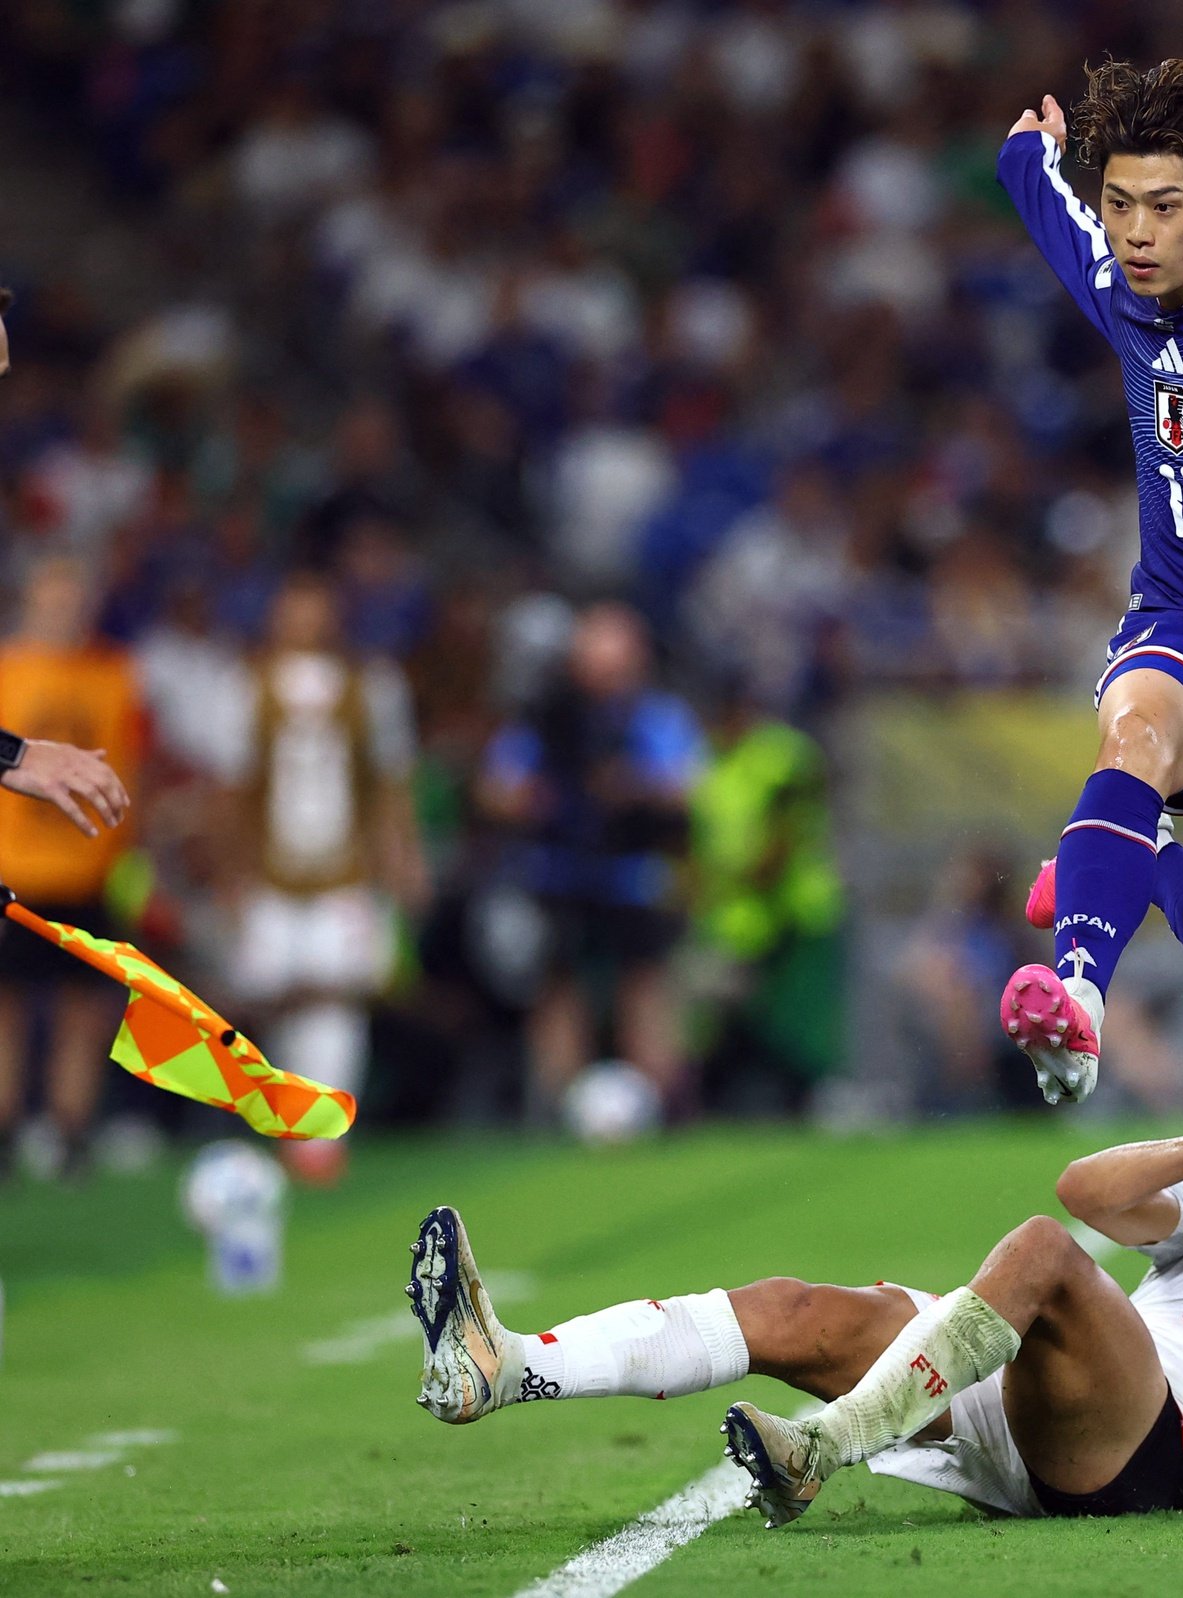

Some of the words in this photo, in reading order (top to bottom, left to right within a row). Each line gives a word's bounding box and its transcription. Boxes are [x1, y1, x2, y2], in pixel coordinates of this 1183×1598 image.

[1162, 384, 1179, 393] JAPAN
[1054, 913, 1117, 939] JAPAN
[910, 1353, 948, 1398] FTF
